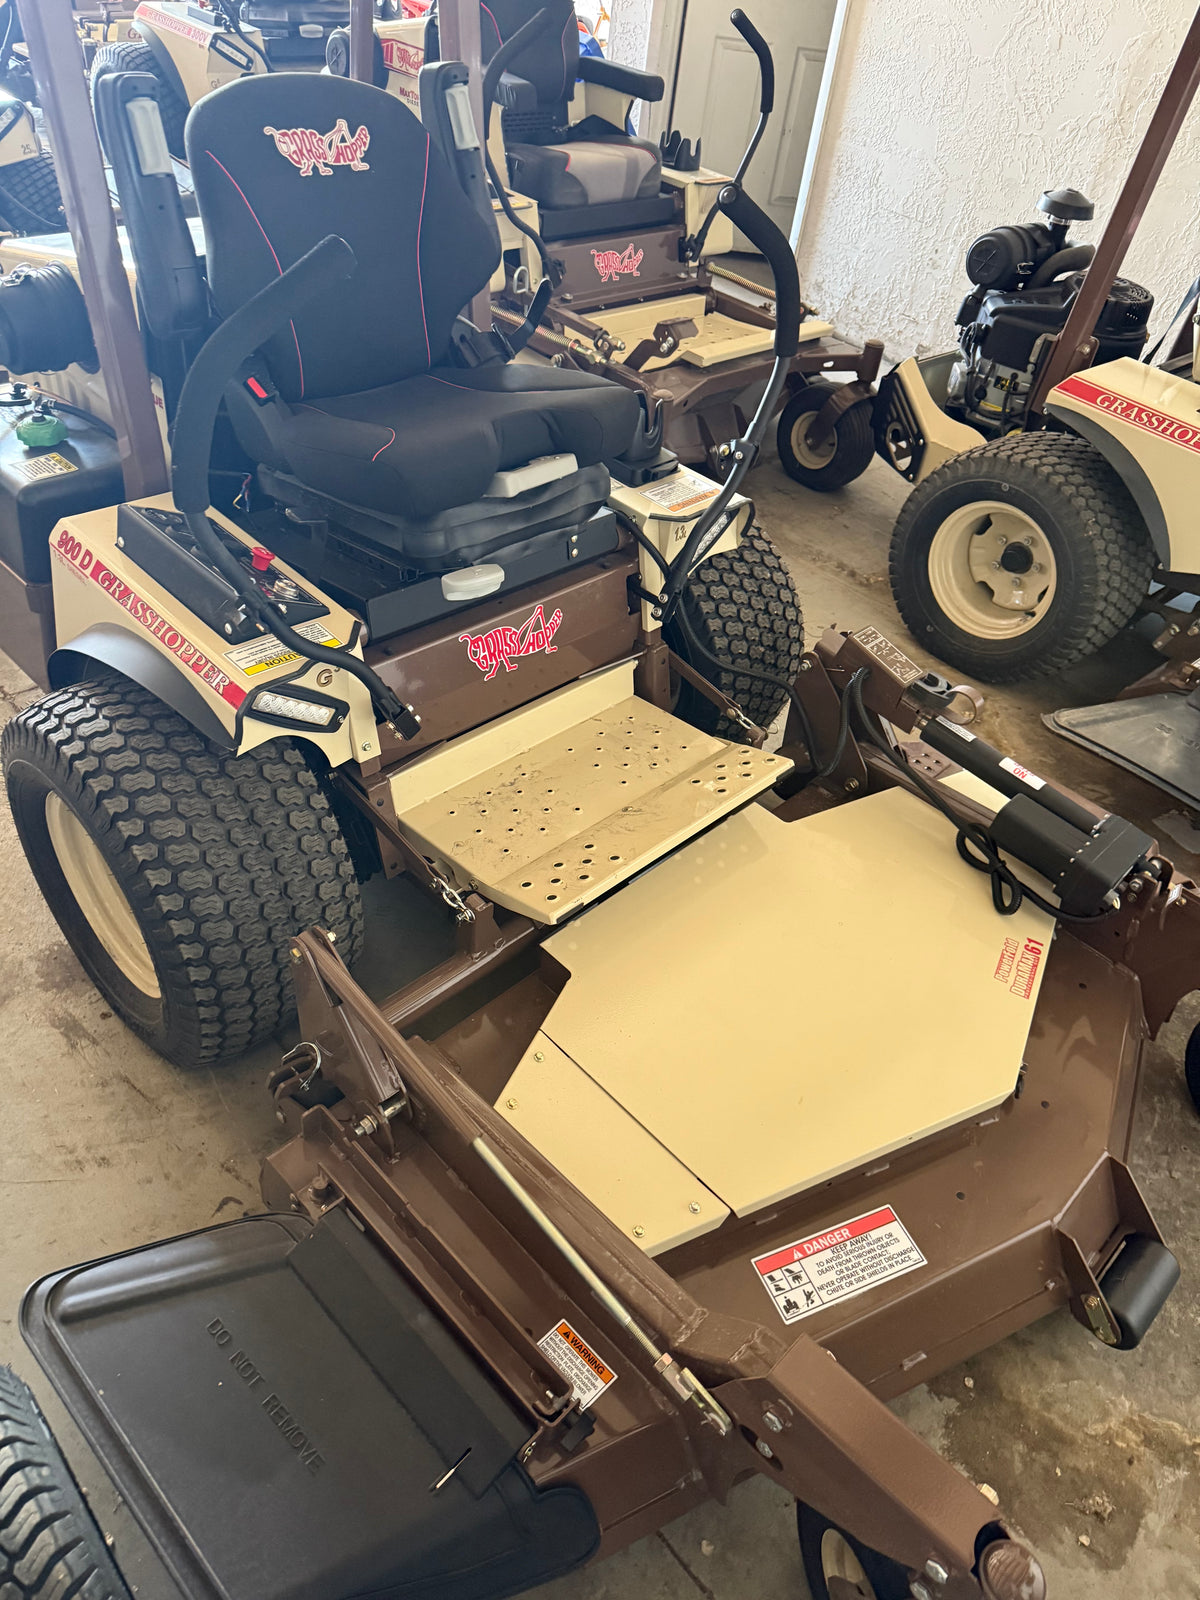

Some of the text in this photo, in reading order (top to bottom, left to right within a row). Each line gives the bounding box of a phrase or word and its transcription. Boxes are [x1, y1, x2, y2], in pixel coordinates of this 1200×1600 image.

[57, 530, 82, 561] 900
[79, 549, 93, 570] D
[98, 569, 231, 696] GRASSHOPPER
[264, 651, 301, 668] UTION
[1024, 936, 1044, 955] 61
[802, 1227, 852, 1254] DANGER
[815, 1231, 894, 1268] TO AVOID SERIOUS INJURY OR
[816, 1236, 900, 1276] DEATH FROM THROWN OBJECTS
[829, 1232, 873, 1255] KEEP AWAY!
[816, 1245, 915, 1292] NEVER OPERATE WITHOUT DISCHARGE
[825, 1283, 846, 1296] CHUTE
[844, 1279, 855, 1288] OR
[853, 1274, 867, 1284] SIDE
[865, 1264, 889, 1278] SHIELDS
[834, 1267, 846, 1276] OR
[844, 1260, 862, 1272] BLADE
[569, 1336, 604, 1375] WARNING
[206, 1317, 326, 1476] DO NOT REMOVE
